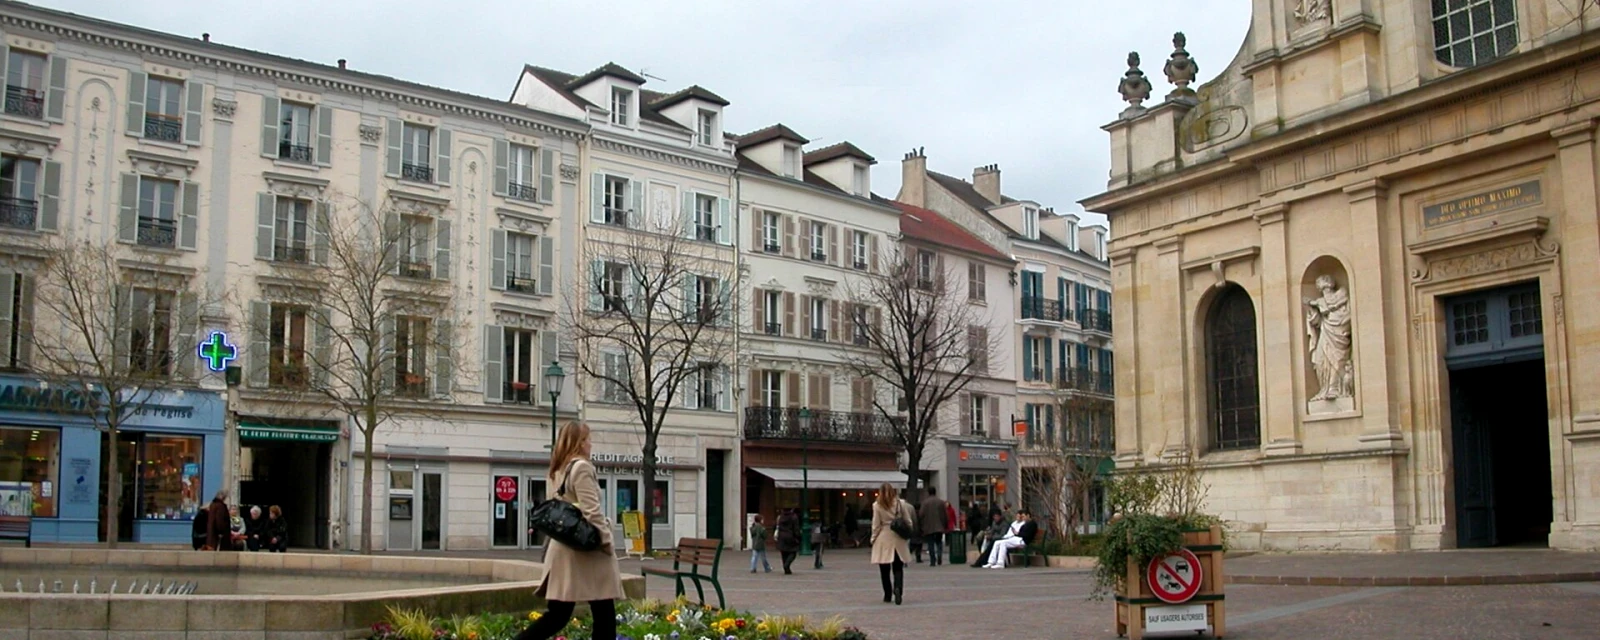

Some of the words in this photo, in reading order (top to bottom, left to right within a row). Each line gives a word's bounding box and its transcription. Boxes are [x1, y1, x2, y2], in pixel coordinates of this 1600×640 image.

[1458, 195, 1486, 210] OPTIMO
[1489, 187, 1521, 203] MAXIMO
[135, 406, 148, 416] de
[590, 452, 621, 462] REDIT
[622, 454, 674, 464] AGROLE
[614, 466, 627, 475] DE
[632, 467, 673, 477] FRNCE
[1148, 615, 1160, 623] SAUF
[1160, 614, 1180, 622] USAGERS
